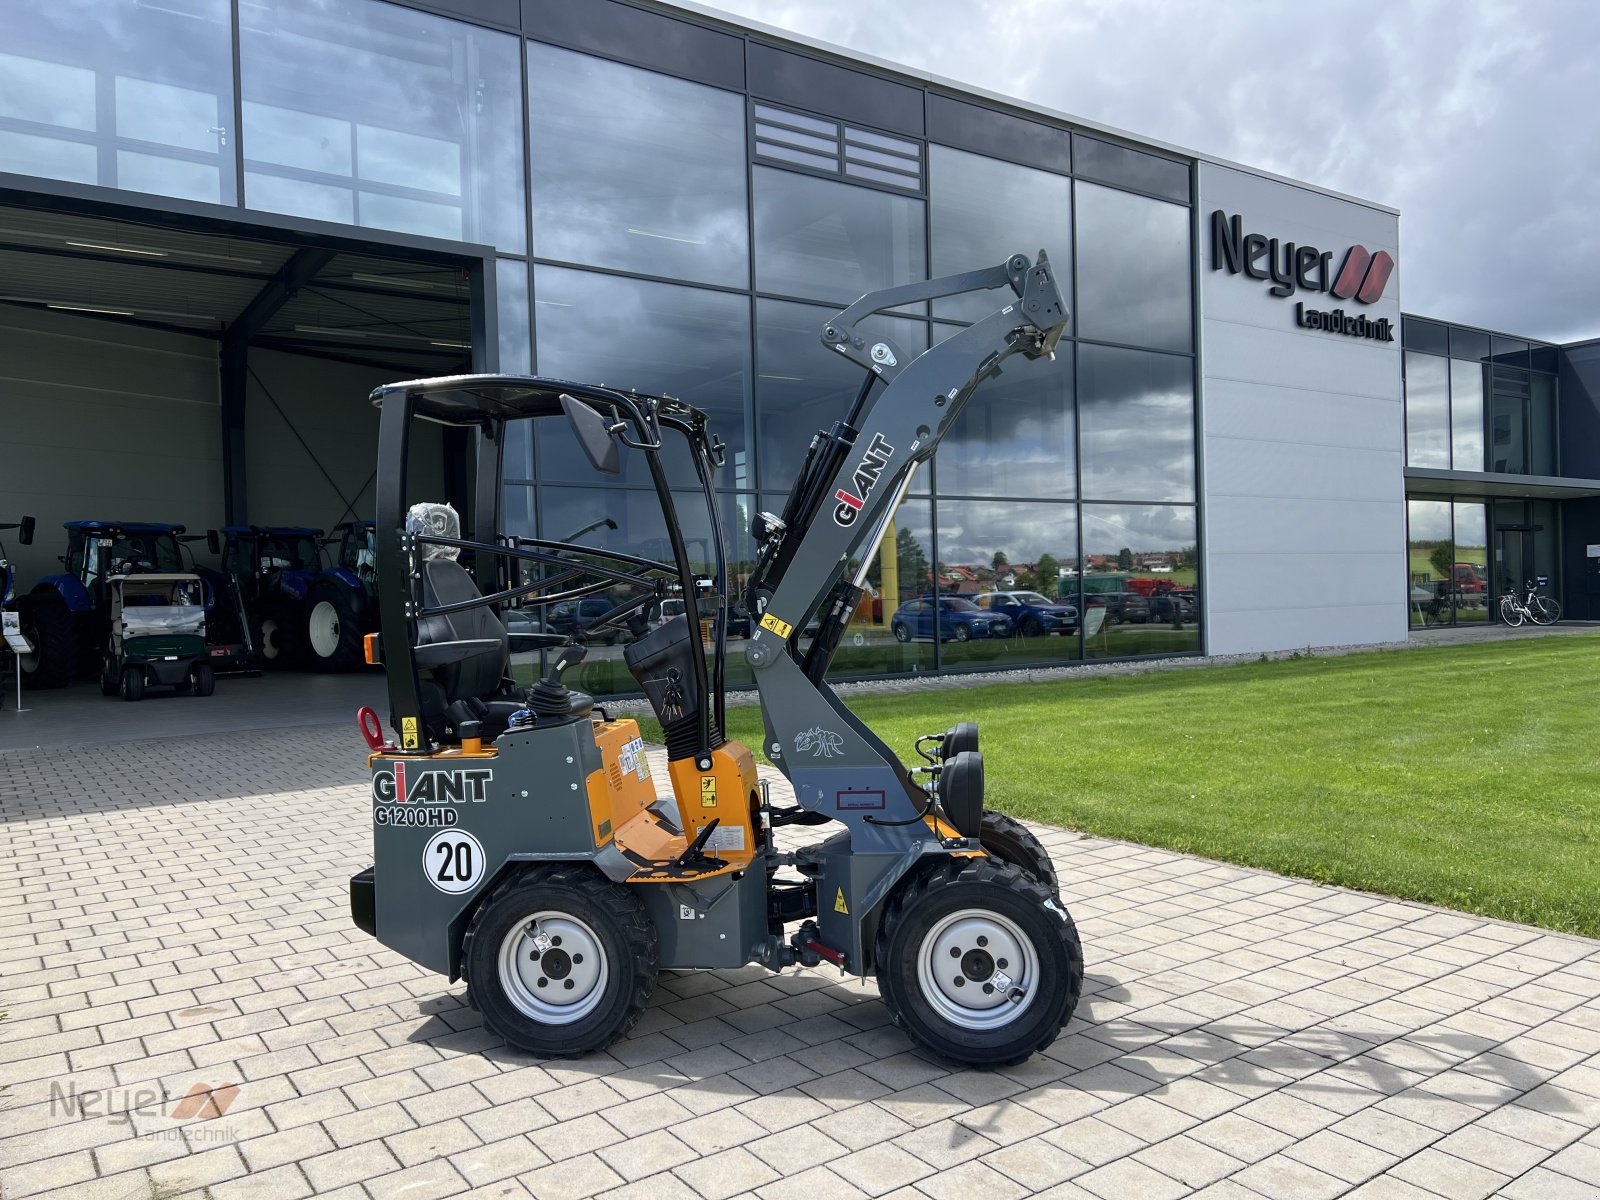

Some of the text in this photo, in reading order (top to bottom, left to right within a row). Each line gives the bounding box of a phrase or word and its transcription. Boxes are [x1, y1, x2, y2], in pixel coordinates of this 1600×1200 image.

[1211, 209, 1333, 297] Neyer
[1295, 301, 1395, 342] Landtechnik
[374, 806, 458, 827] G1200HD
[436, 841, 473, 882] 20
